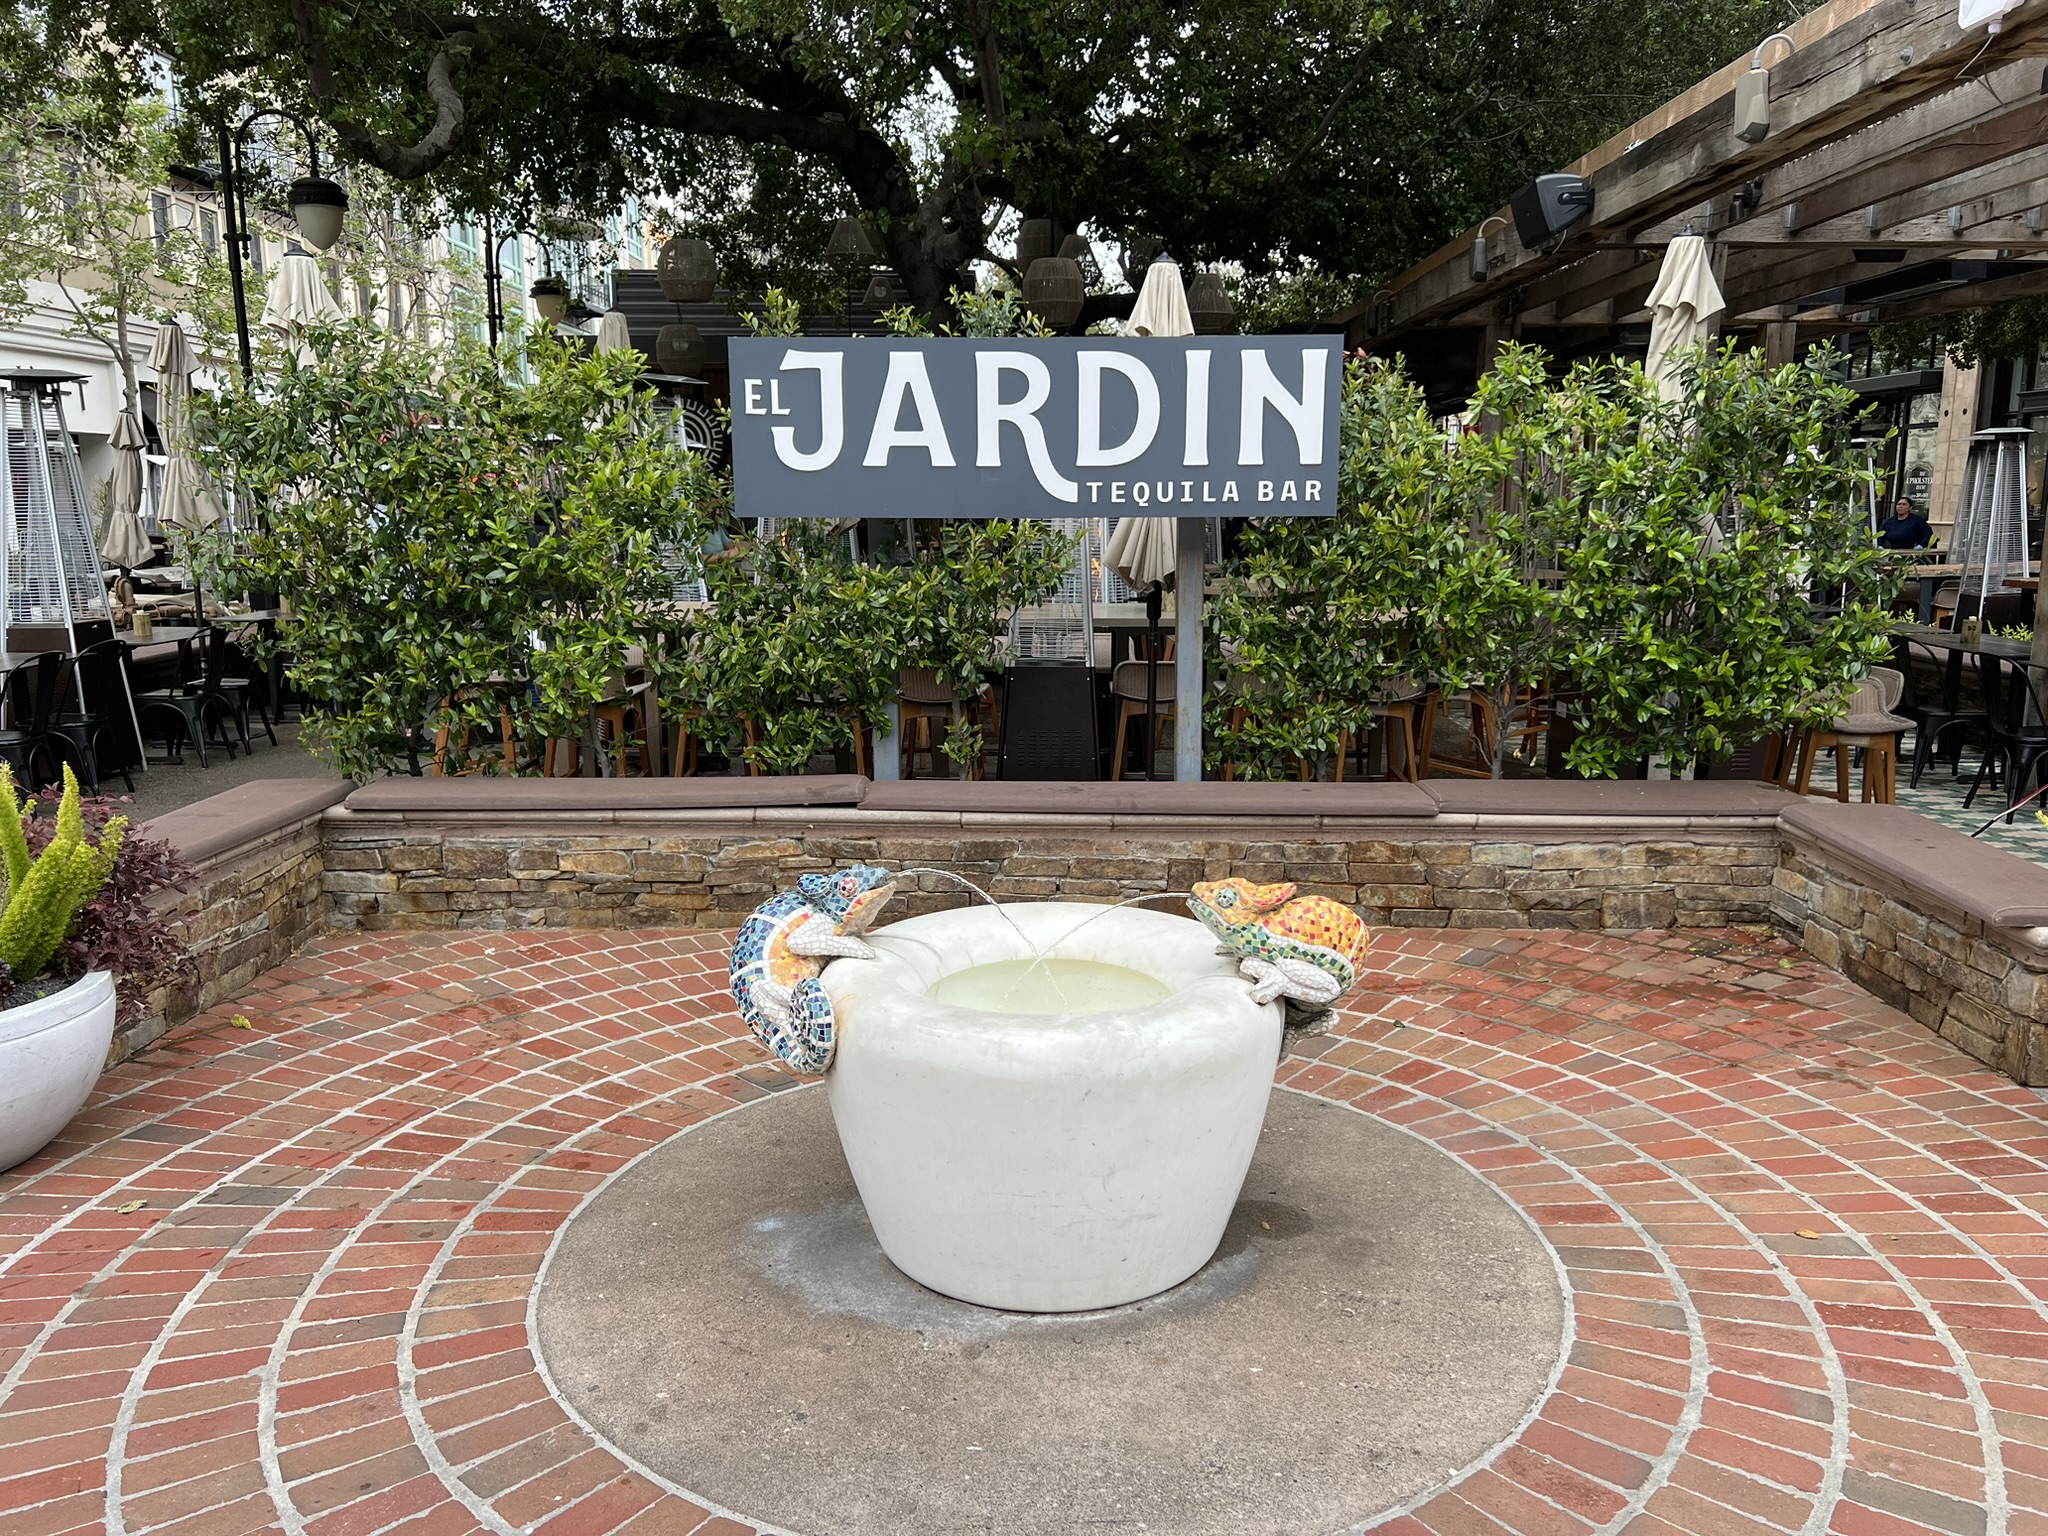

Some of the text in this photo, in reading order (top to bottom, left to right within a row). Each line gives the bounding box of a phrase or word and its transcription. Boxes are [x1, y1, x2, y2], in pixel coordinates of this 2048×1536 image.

[743, 348, 1329, 503] EL JARDIN
[1085, 480, 1322, 507] TEQUILA BAR
